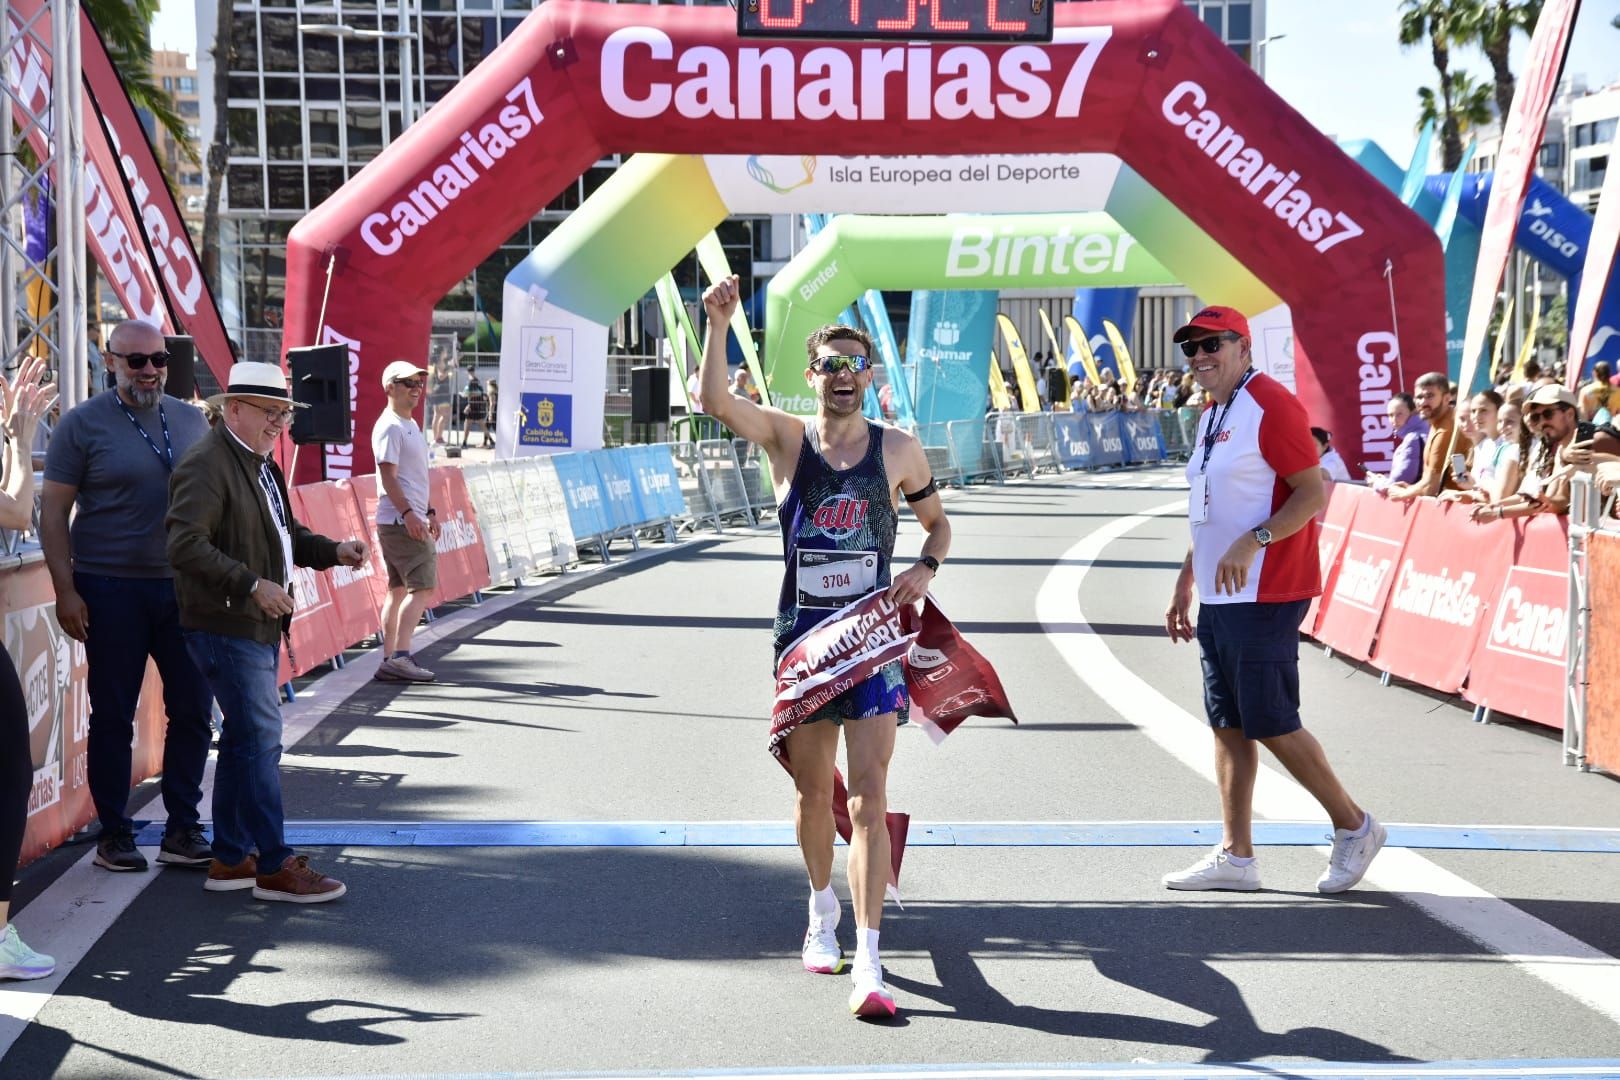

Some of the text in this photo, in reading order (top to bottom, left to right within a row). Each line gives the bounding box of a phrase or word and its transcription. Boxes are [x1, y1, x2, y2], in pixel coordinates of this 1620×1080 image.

[600, 26, 1112, 120] Canarias7
[359, 77, 545, 256] Canarias7
[829, 163, 1080, 186] Isla Europea del Deporte
[1161, 81, 1364, 254] Canarias7
[944, 225, 1137, 278] Binter
[799, 260, 838, 301] Binter
[1357, 331, 1399, 473] Canari
[525, 428, 553, 436] Cabildo
[541, 436, 568, 444] Canaria
[813, 499, 869, 529] all!
[822, 573, 850, 589] 3704
